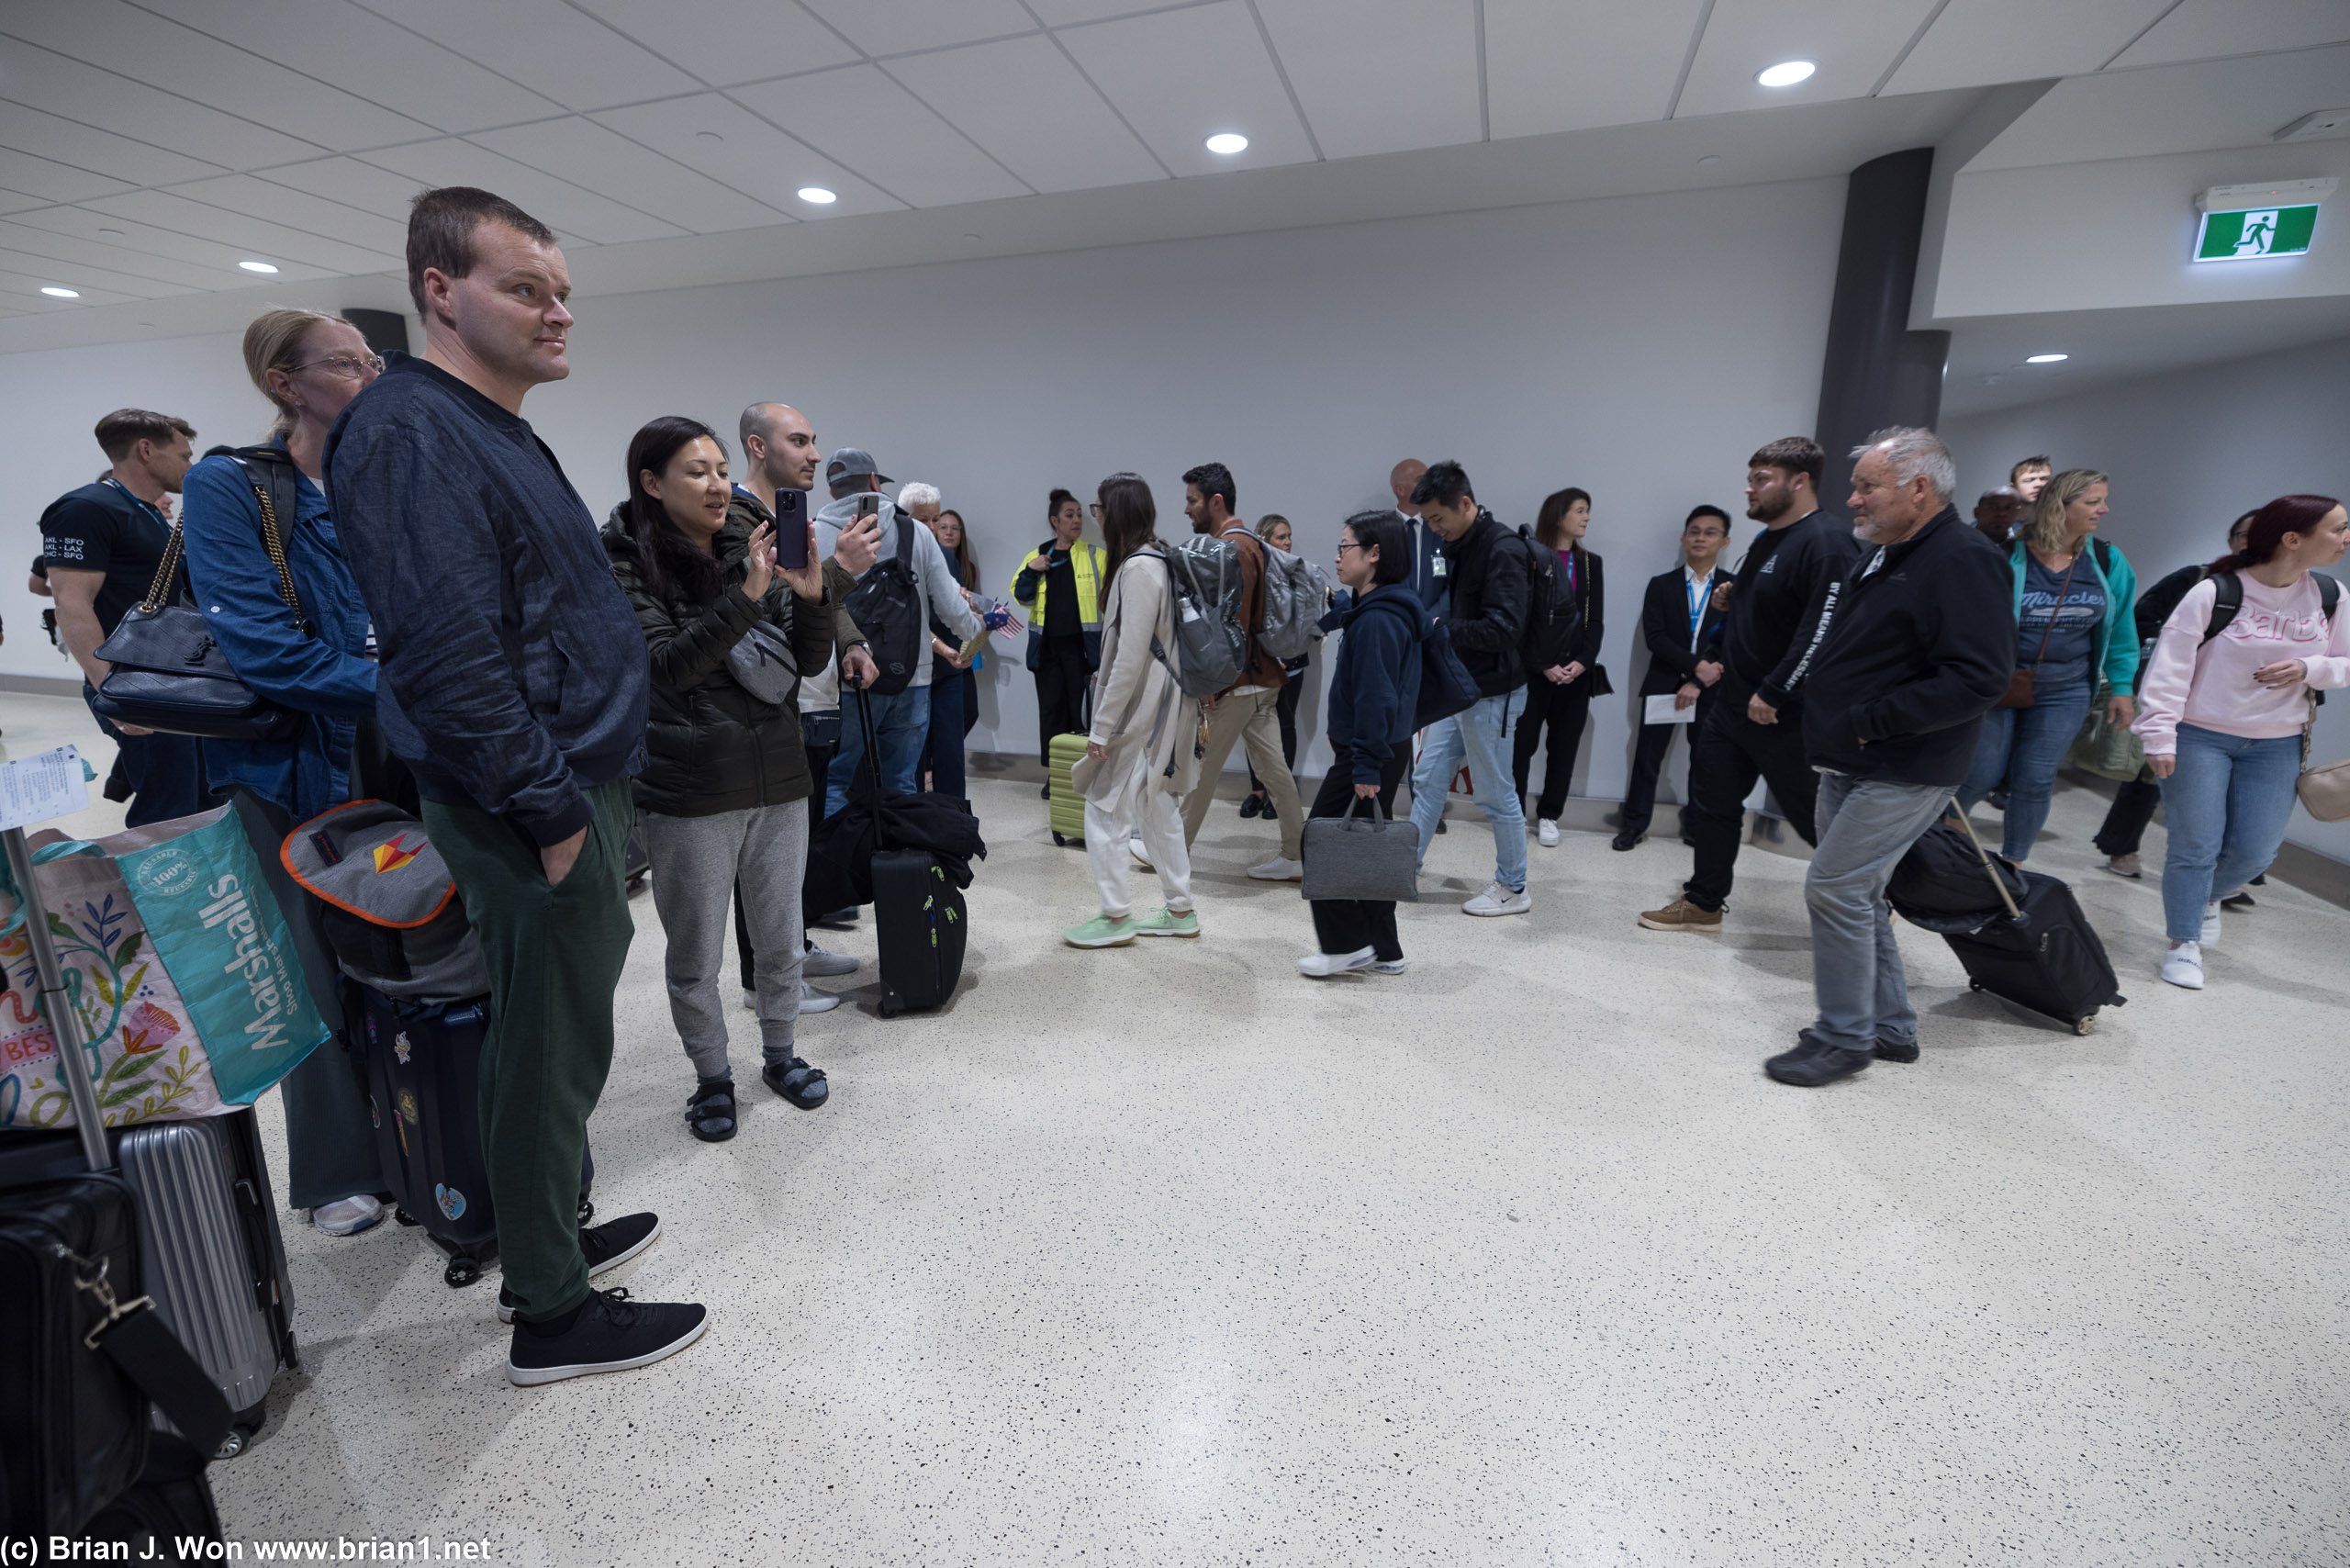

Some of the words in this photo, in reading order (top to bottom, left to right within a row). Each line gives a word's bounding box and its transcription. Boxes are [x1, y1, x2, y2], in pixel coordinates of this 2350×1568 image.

[64, 537, 84, 545] SFO
[64, 544, 83, 553] LAX
[63, 552, 84, 560] SFO
[1828, 582, 1841, 594] BY
[1824, 595, 1837, 610] ALL
[1812, 611, 1832, 643] MEANS
[2224, 604, 2329, 642] Barb
[152, 861, 187, 886] 100%
[198, 874, 289, 1050] Marshalls
[284, 981, 297, 1015] Shop
[5, 1032, 53, 1061] BES
